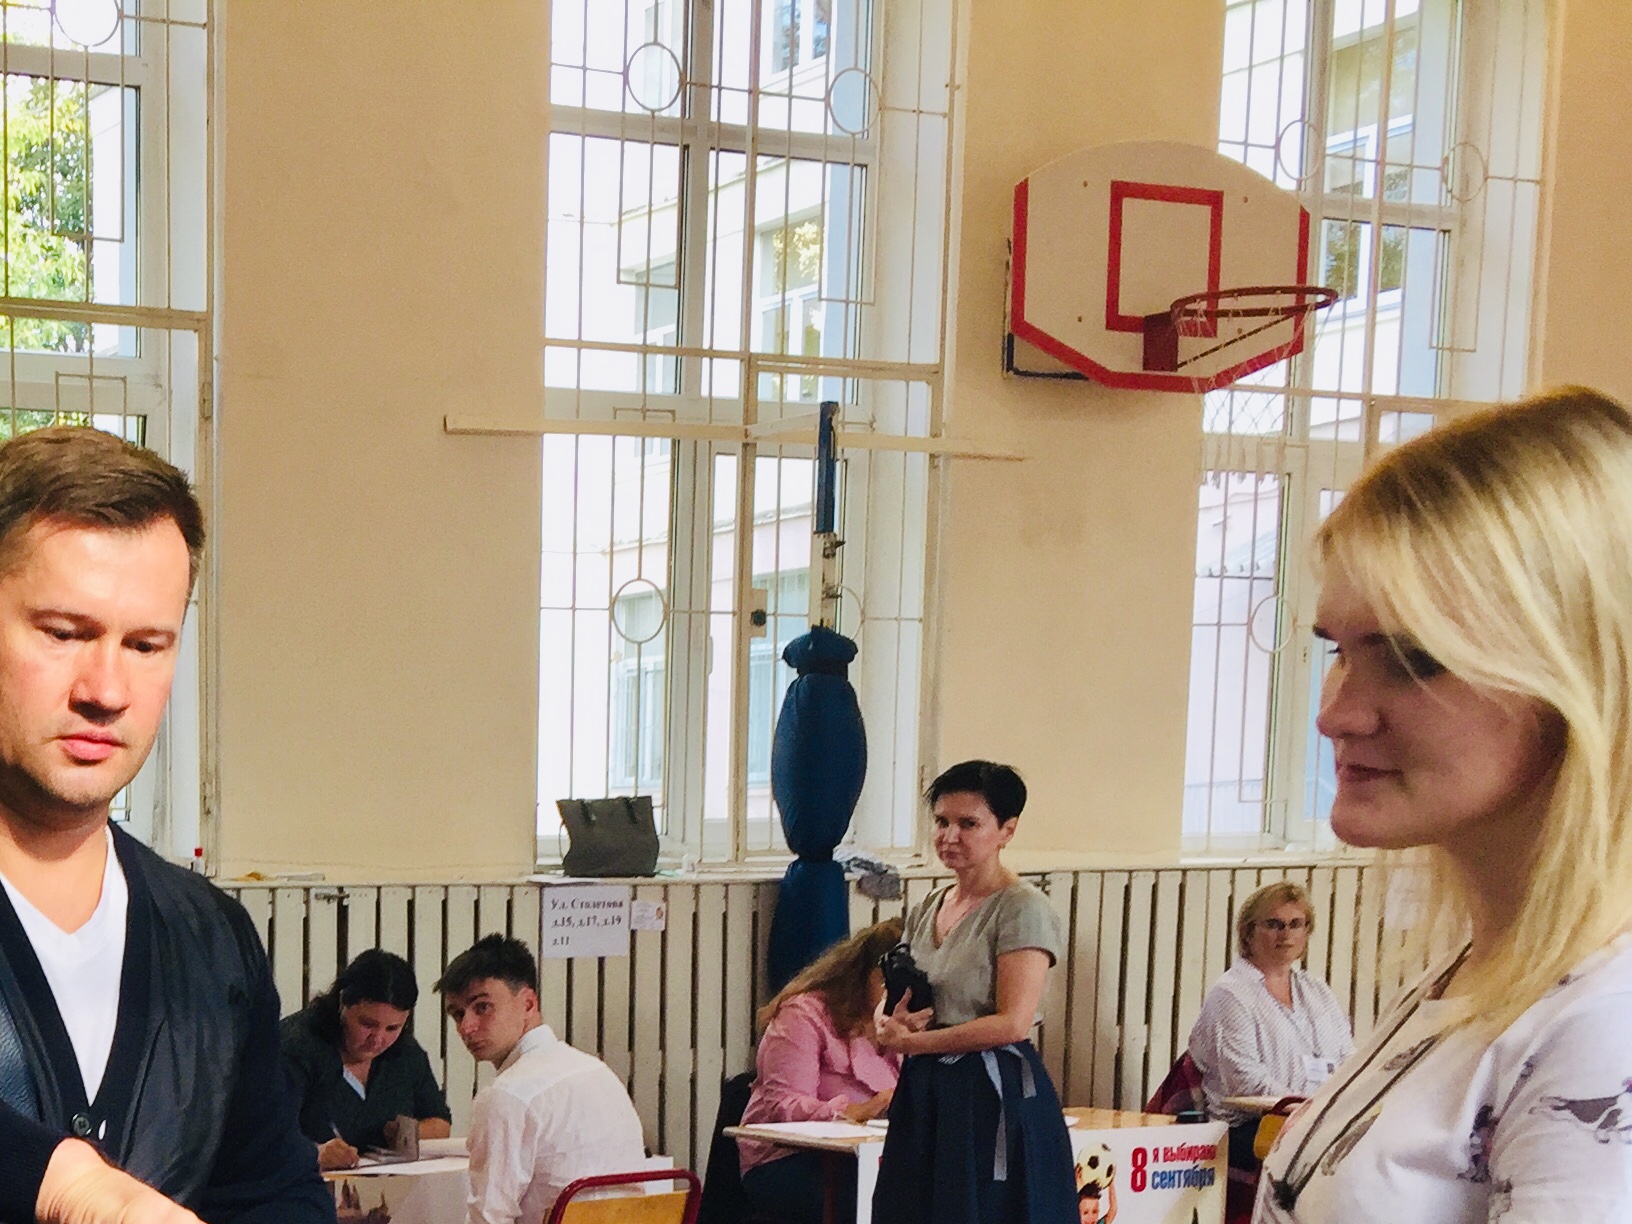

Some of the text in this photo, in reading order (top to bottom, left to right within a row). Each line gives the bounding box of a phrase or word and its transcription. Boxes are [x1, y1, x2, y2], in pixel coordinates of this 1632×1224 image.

[1152, 1142, 1217, 1164] я выбираю
[1131, 1147, 1147, 1193] 8
[1151, 1164, 1215, 1191] сентября
